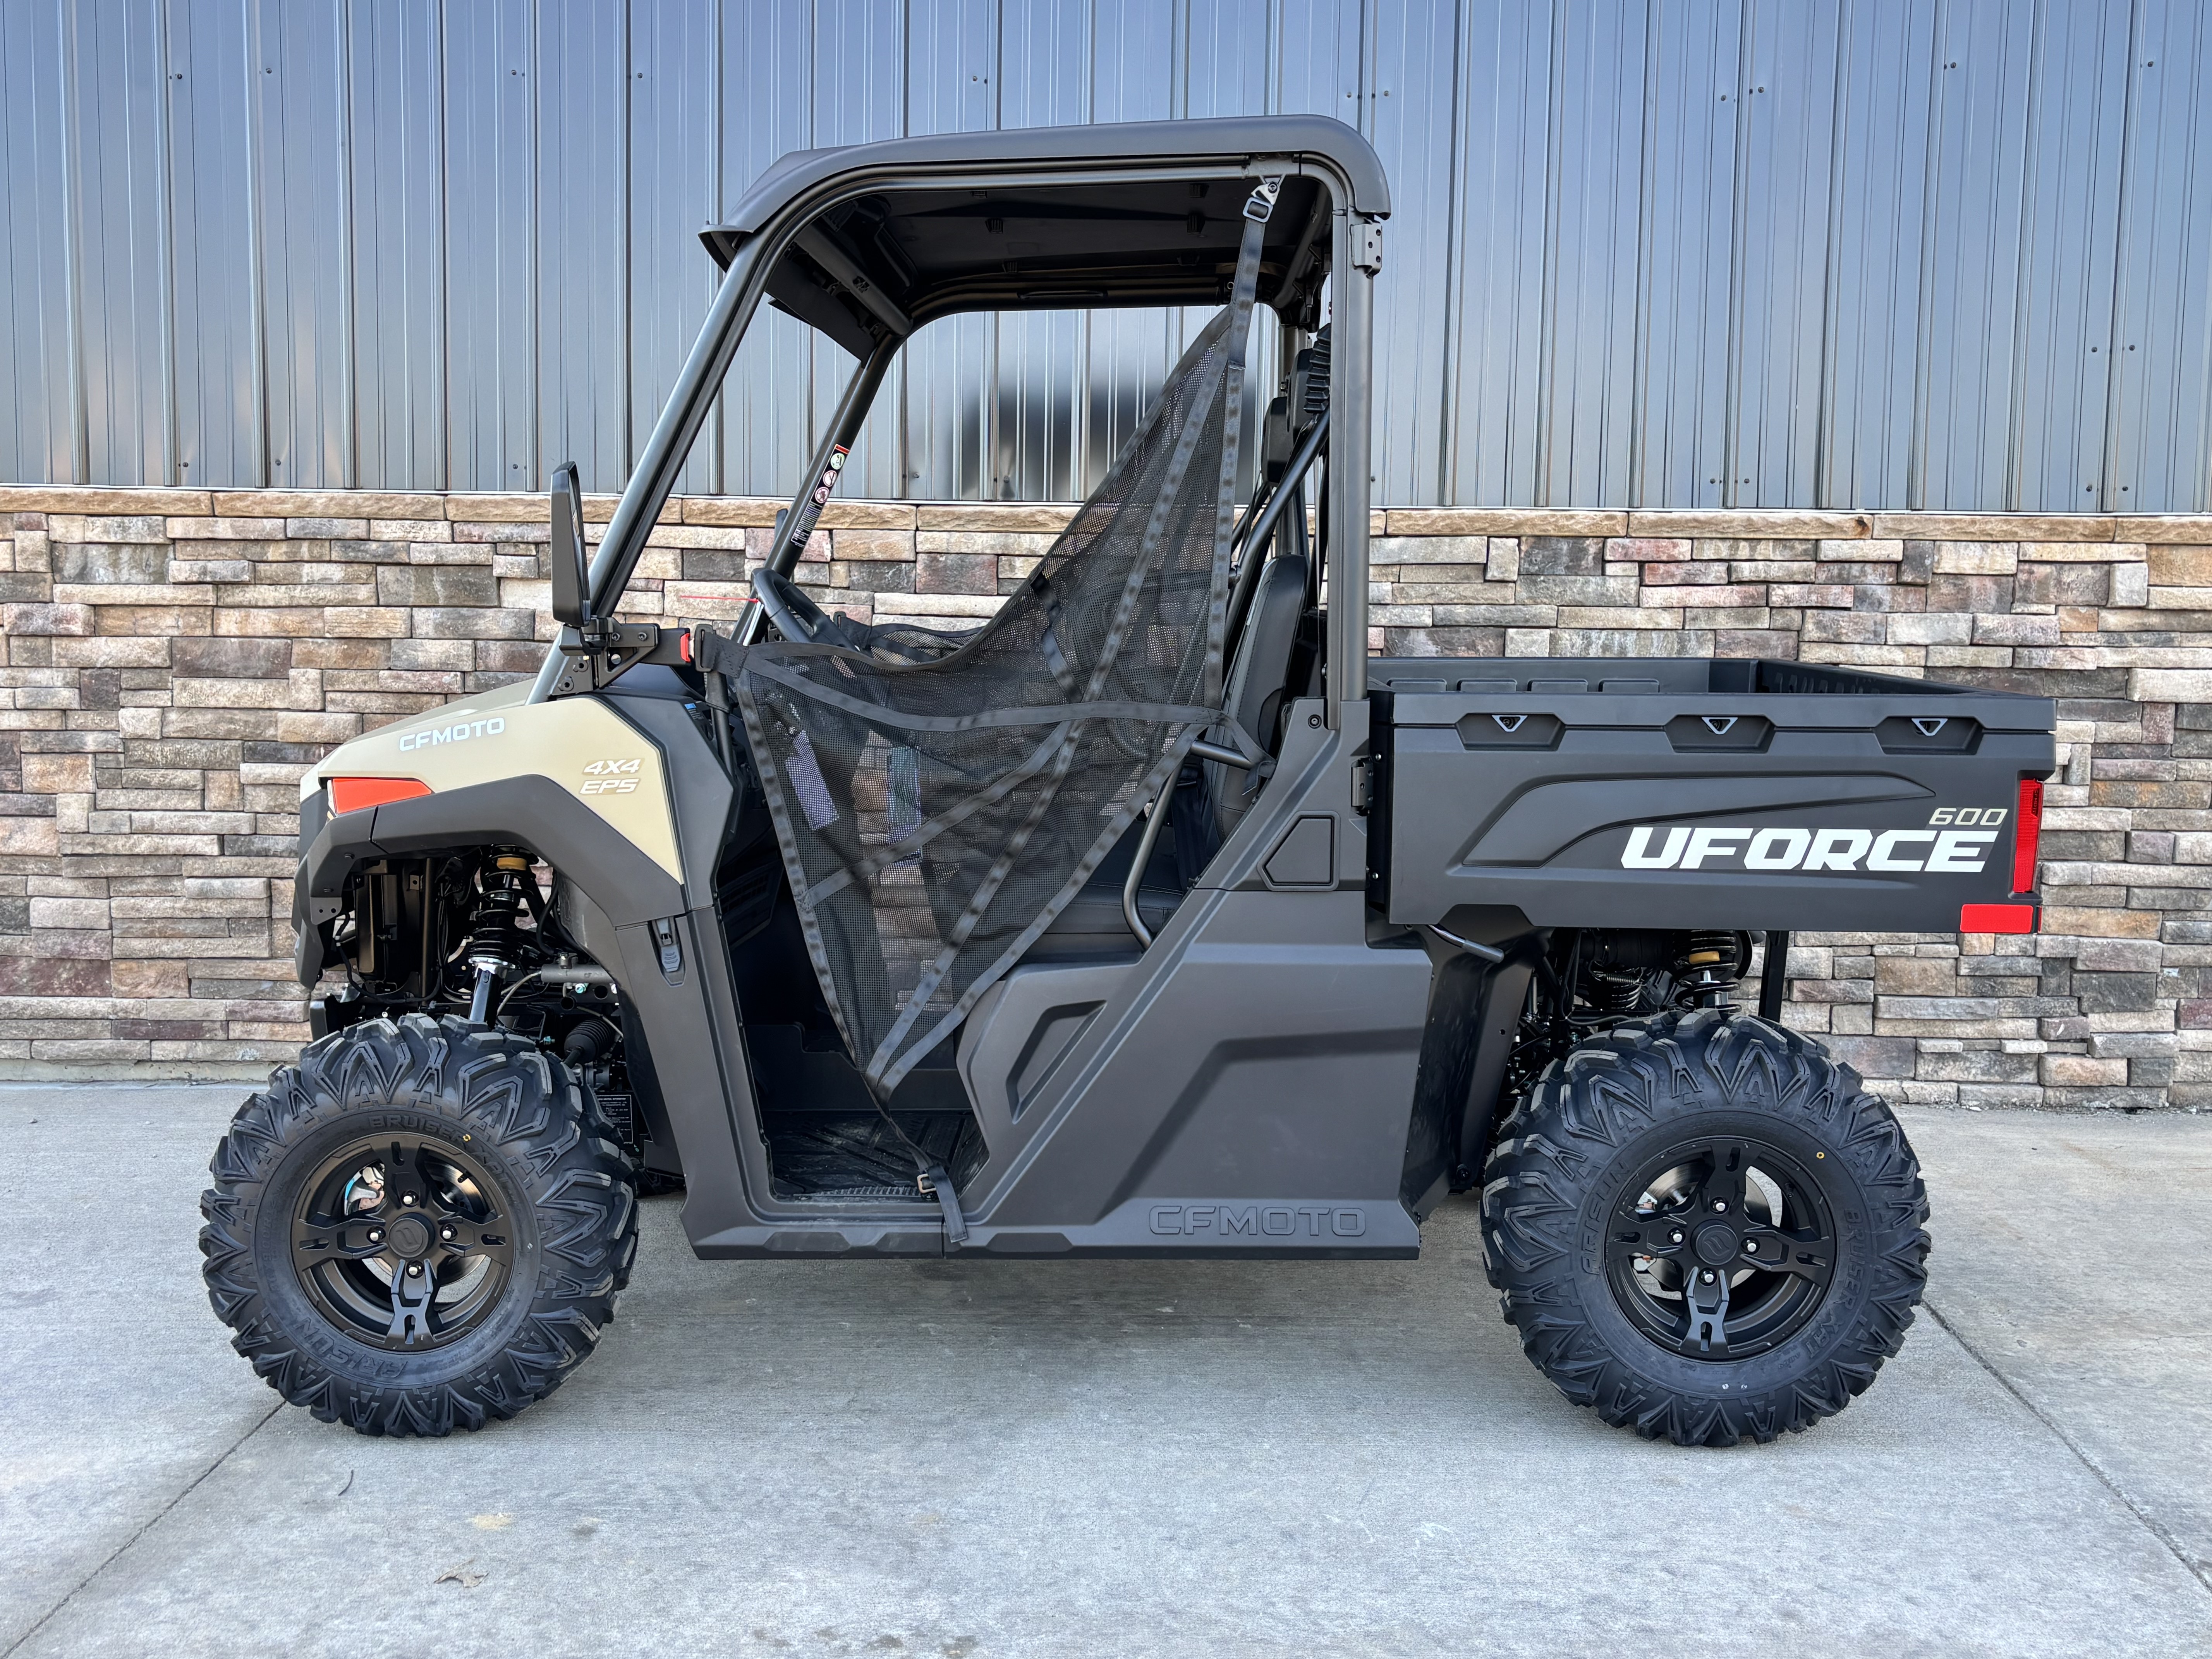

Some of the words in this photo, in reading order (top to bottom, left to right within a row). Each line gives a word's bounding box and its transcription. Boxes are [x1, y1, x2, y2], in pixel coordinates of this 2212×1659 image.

[399, 717, 505, 751] CFMOTO
[584, 759, 641, 775] 4X4
[580, 778, 639, 794] EPS
[1929, 807, 2008, 825] 600
[1621, 827, 1998, 872] UFORCE
[369, 1115, 466, 1149] BRUISER
[1149, 1206, 1365, 1237] CFMOTO
[1581, 1161, 1629, 1275] ARISUN
[1833, 1209, 1865, 1310] BRUISER
[294, 1317, 408, 1379] ARISUN
[1805, 1308, 1844, 1358] XAT
